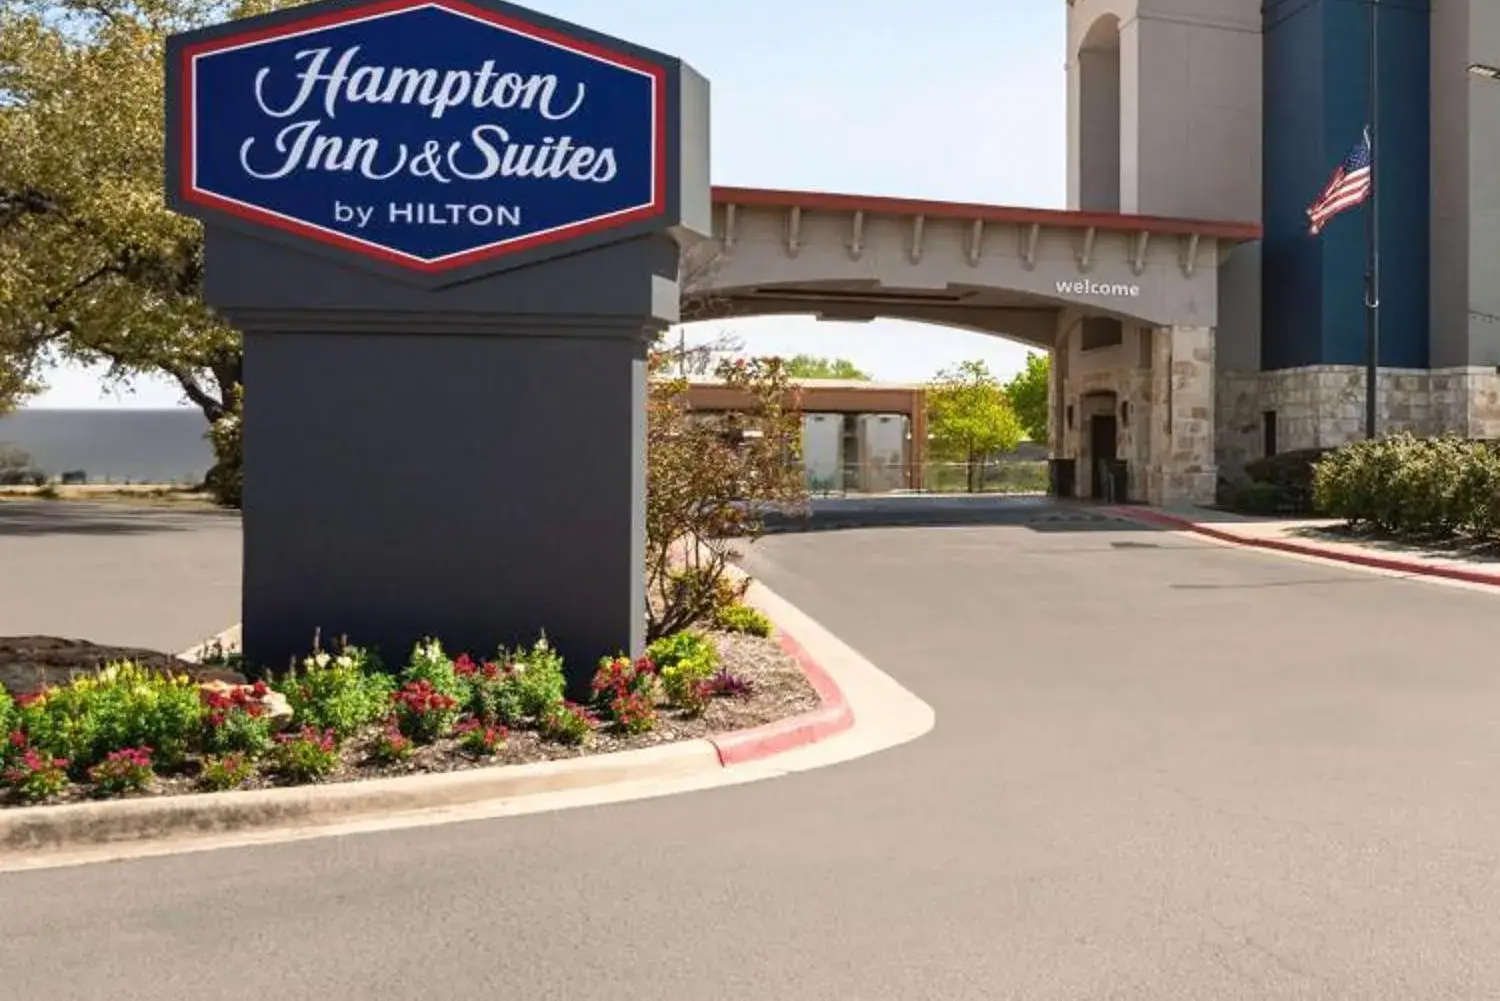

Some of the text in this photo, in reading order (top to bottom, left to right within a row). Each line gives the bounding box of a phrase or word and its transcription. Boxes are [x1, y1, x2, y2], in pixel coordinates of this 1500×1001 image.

[255, 45, 585, 119] Hampton
[240, 120, 617, 183] Inn & Suites
[334, 201, 520, 228] by HILTON
[1055, 279, 1140, 296] welcome
